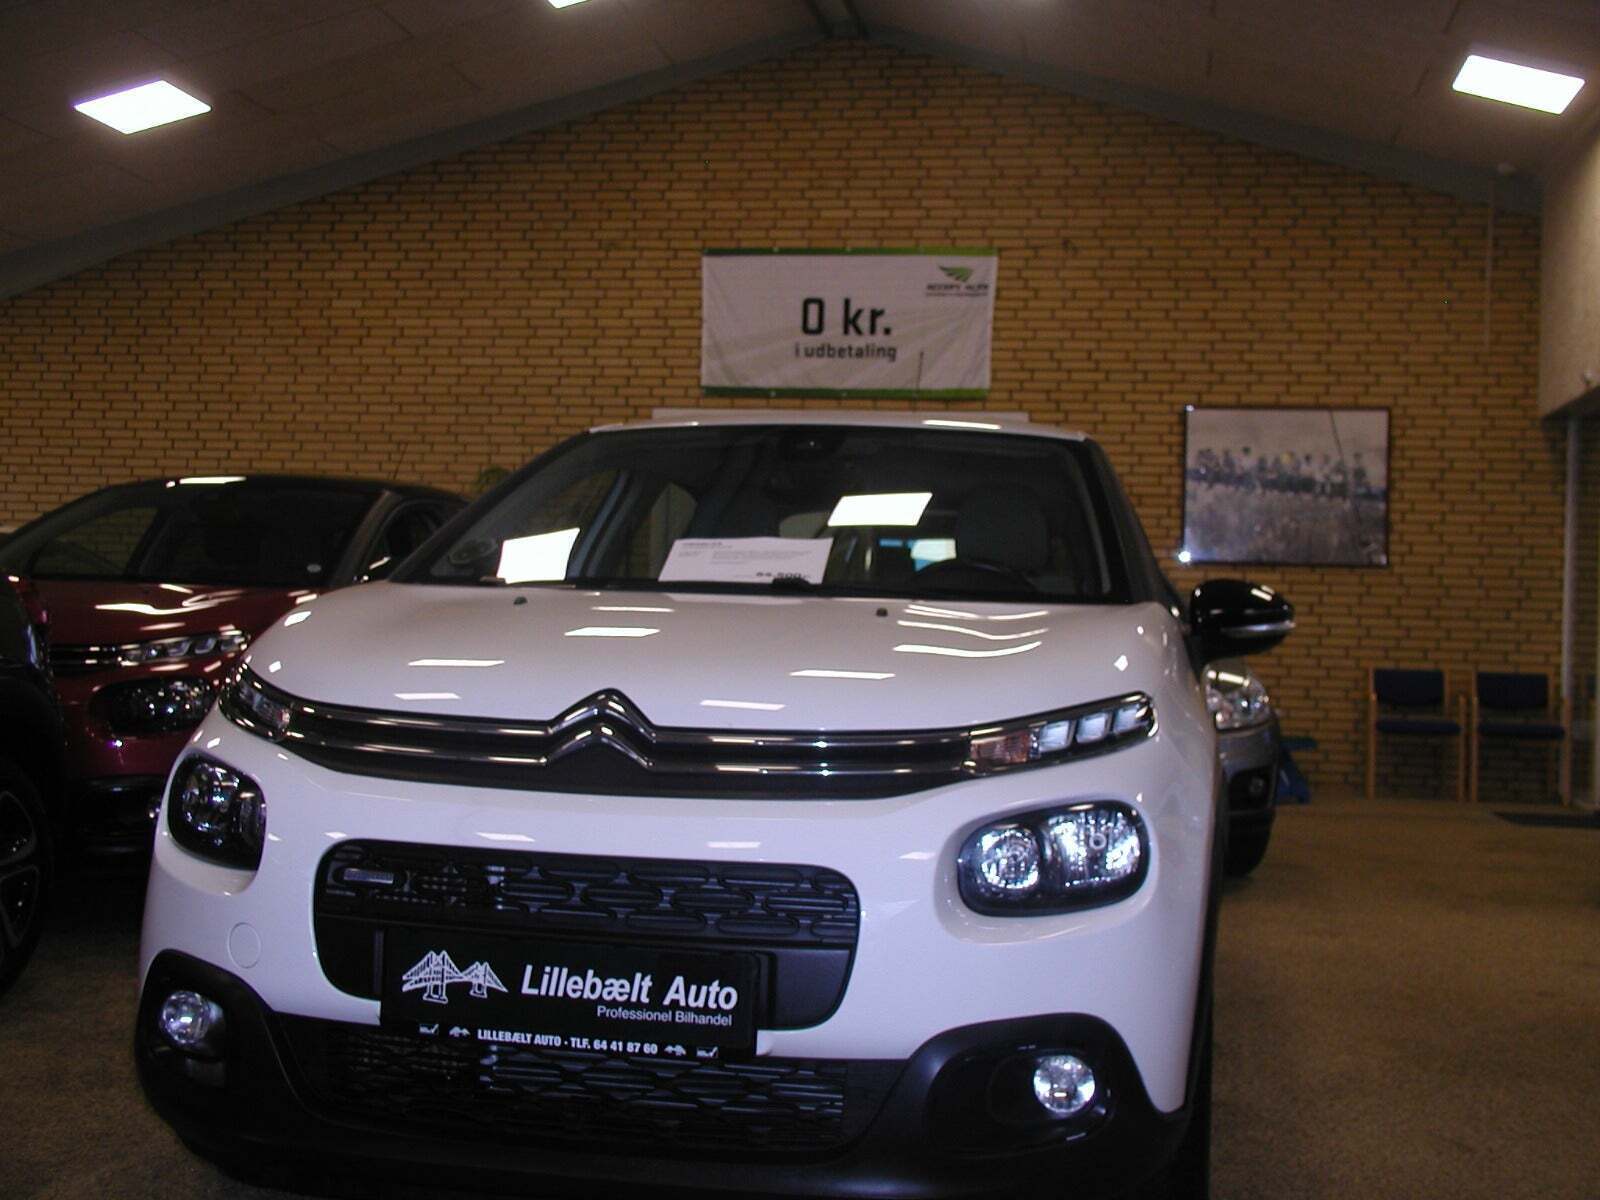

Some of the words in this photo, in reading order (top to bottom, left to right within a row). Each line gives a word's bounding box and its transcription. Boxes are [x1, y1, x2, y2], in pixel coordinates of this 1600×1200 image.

[802, 298, 825, 334] 0
[843, 298, 892, 335] kr.
[804, 343, 897, 362] udbetaling
[521, 964, 652, 1003] Lillebælt
[663, 976, 738, 1011] Auto
[597, 1005, 672, 1022] Professionel
[676, 1011, 733, 1027] Bilhandel
[477, 1029, 531, 1044] LILLEBÆLT
[534, 1034, 562, 1046] AUTO
[570, 1037, 592, 1049] TLF.
[593, 1039, 608, 1051] 64
[610, 1040, 624, 1052] 41
[627, 1041, 641, 1053] 87
